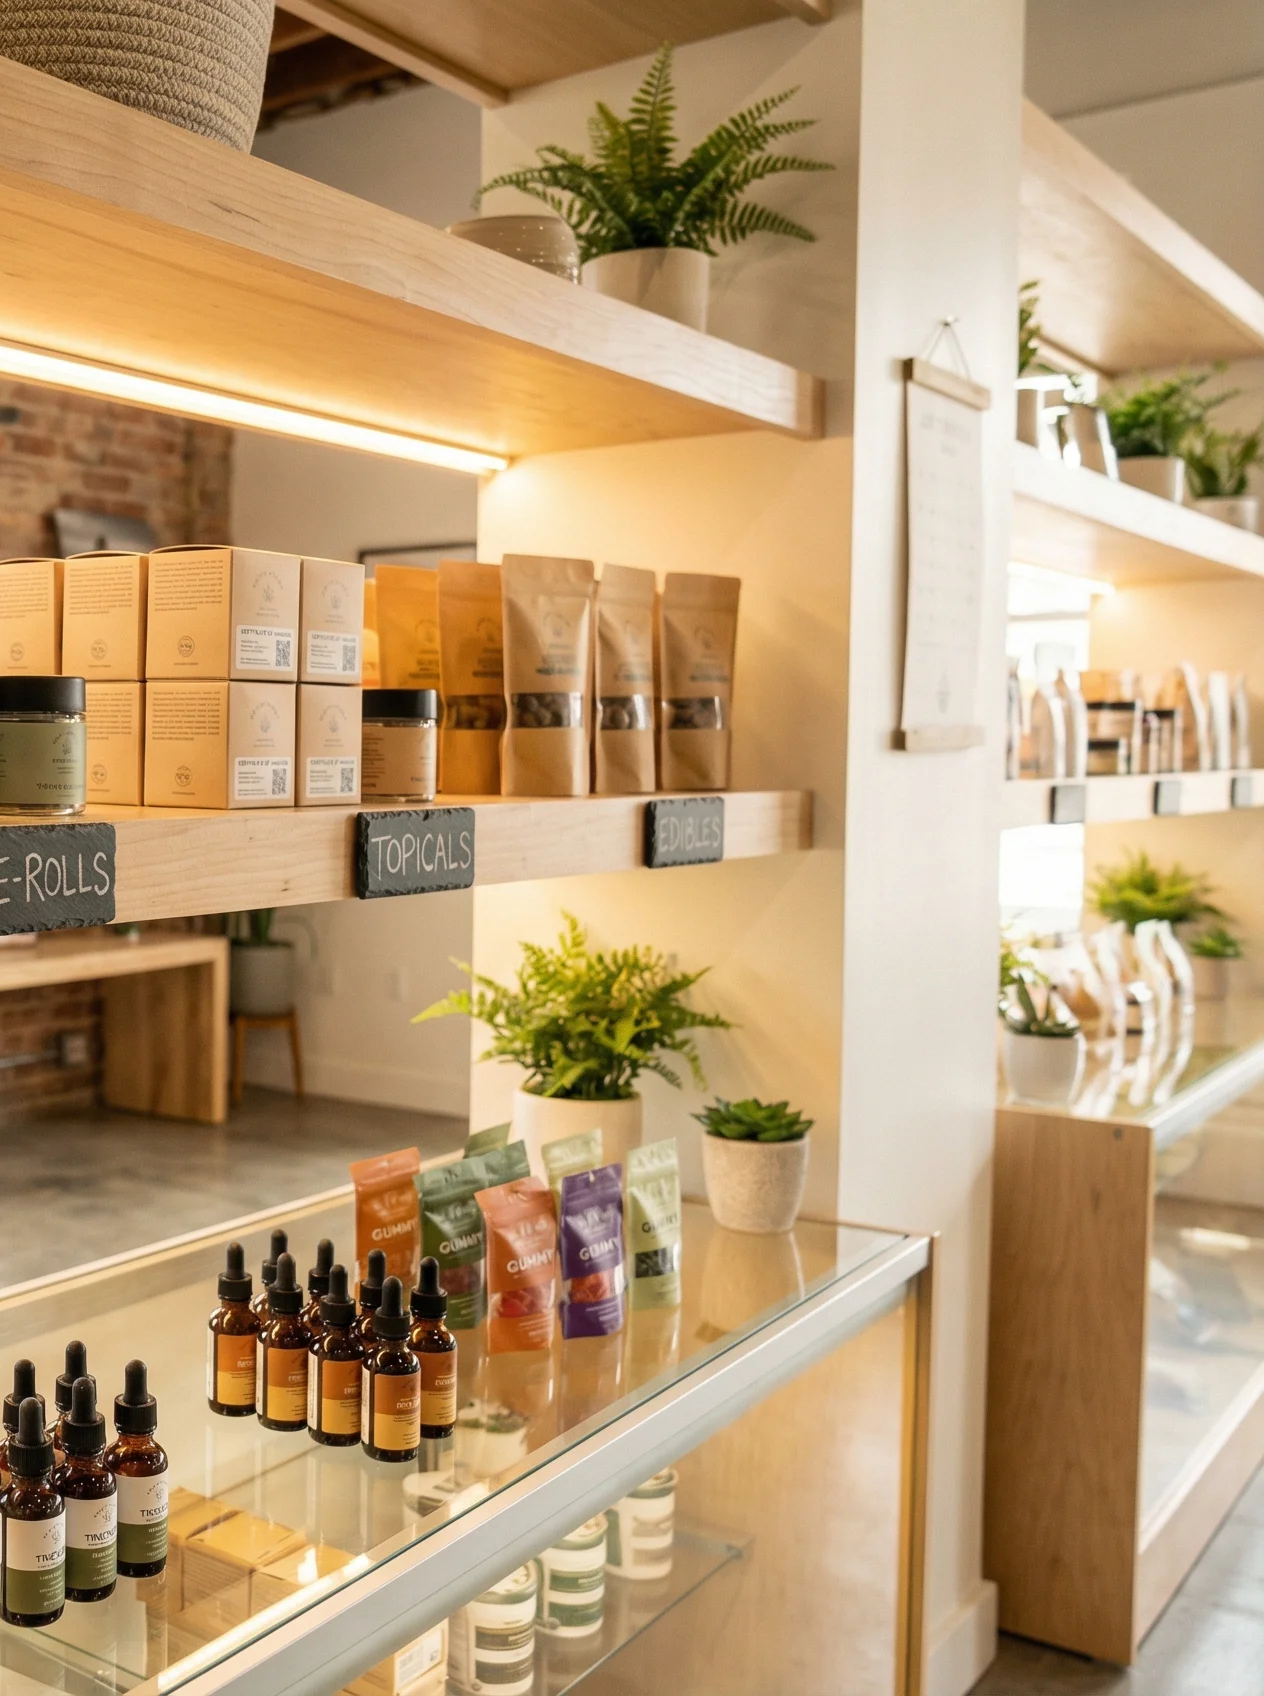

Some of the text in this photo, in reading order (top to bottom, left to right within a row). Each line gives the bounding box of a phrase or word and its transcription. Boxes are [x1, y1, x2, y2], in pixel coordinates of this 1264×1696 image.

[658, 815, 722, 853] EDIBLES
[371, 830, 472, 882] TOPICALS
[372, 1218, 419, 1242] GUMMY
[439, 1231, 484, 1255] GUMMY
[506, 1248, 555, 1274] GUMMY
